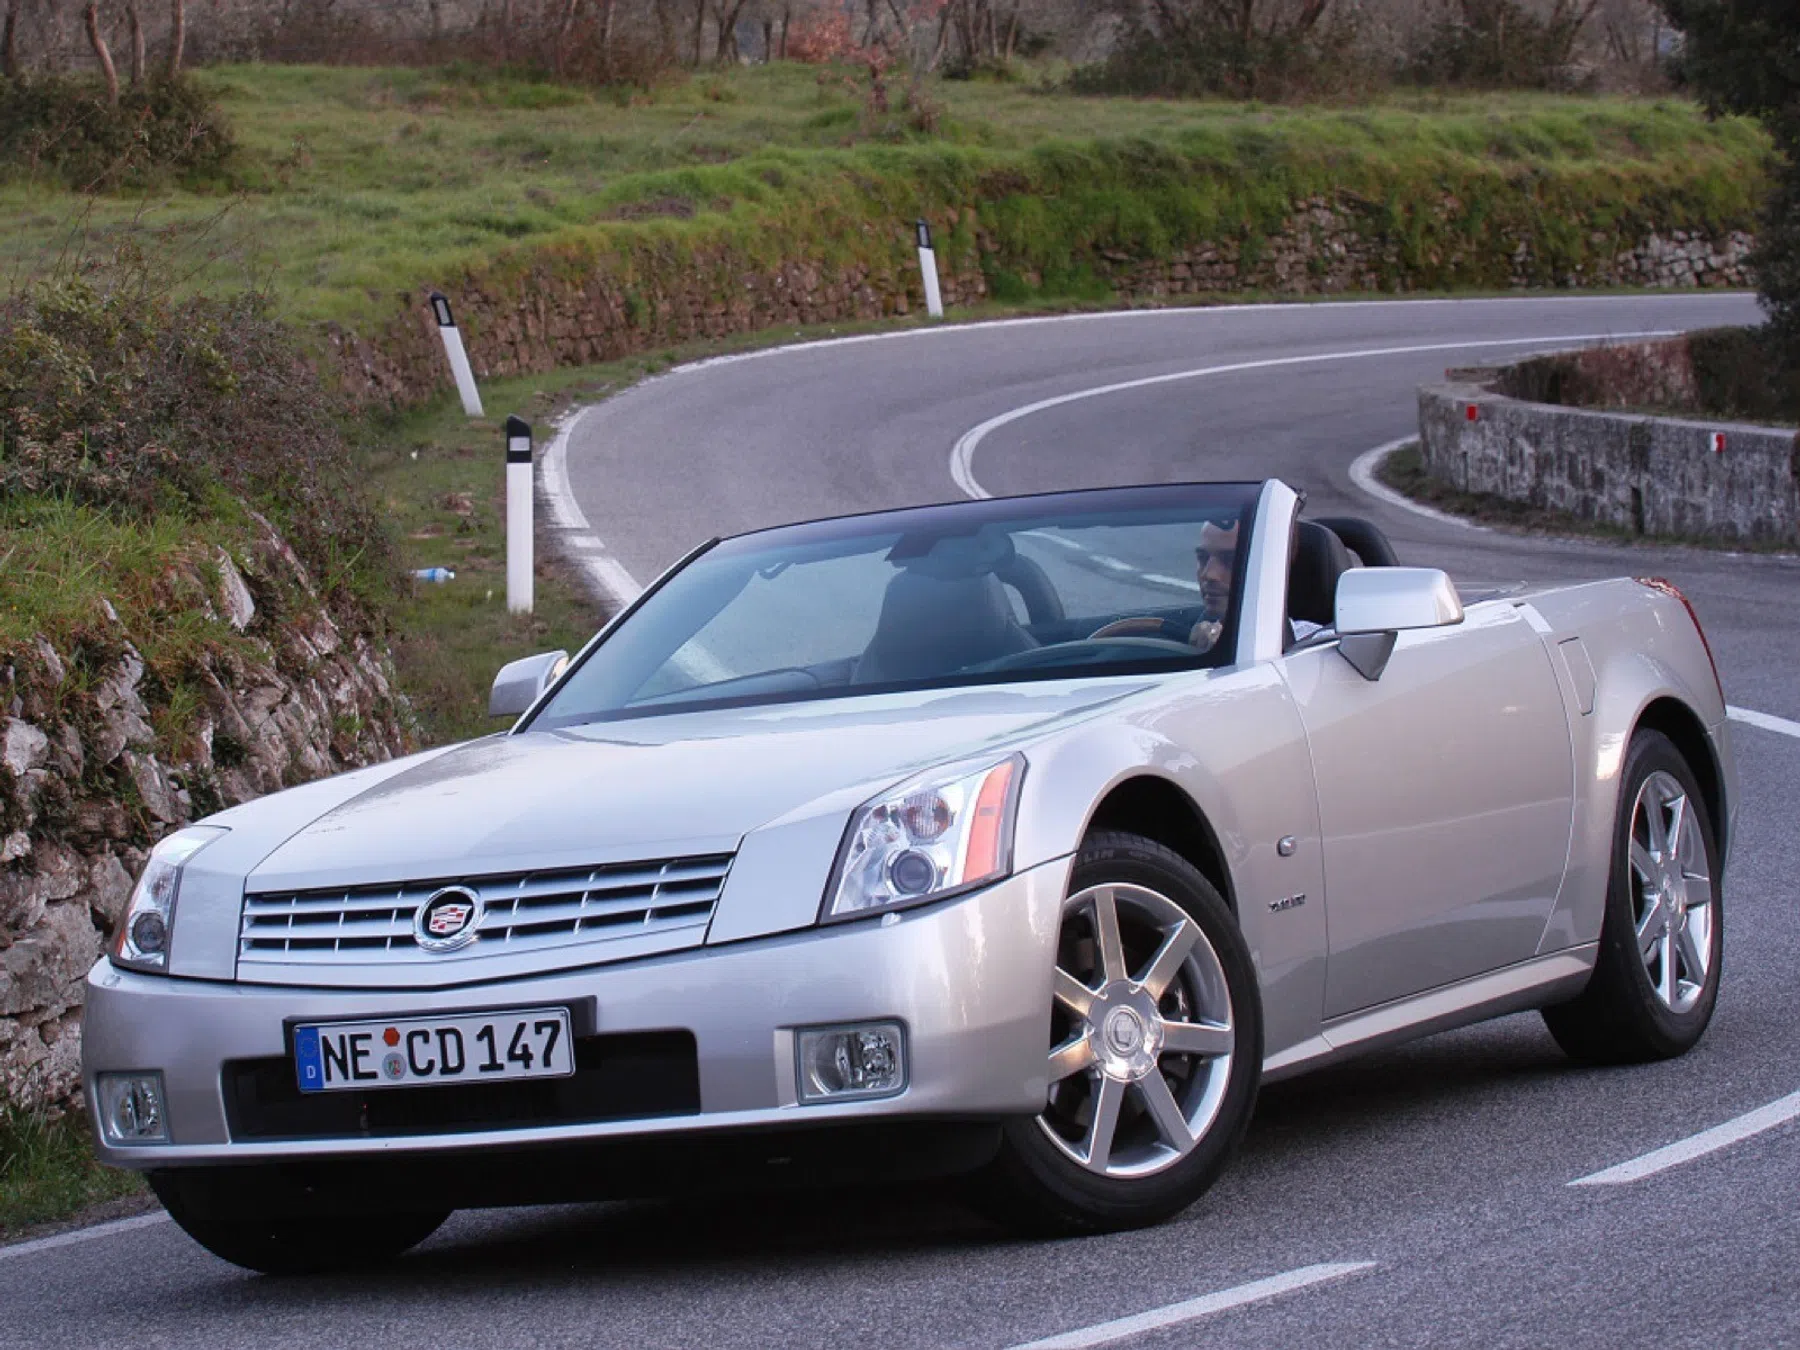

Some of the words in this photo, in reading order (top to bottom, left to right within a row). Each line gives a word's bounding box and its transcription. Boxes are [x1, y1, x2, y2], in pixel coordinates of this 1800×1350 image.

[321, 1033, 378, 1082] NE
[406, 1028, 465, 1077] CD
[476, 1020, 561, 1072] 147
[305, 1065, 317, 1079] D
